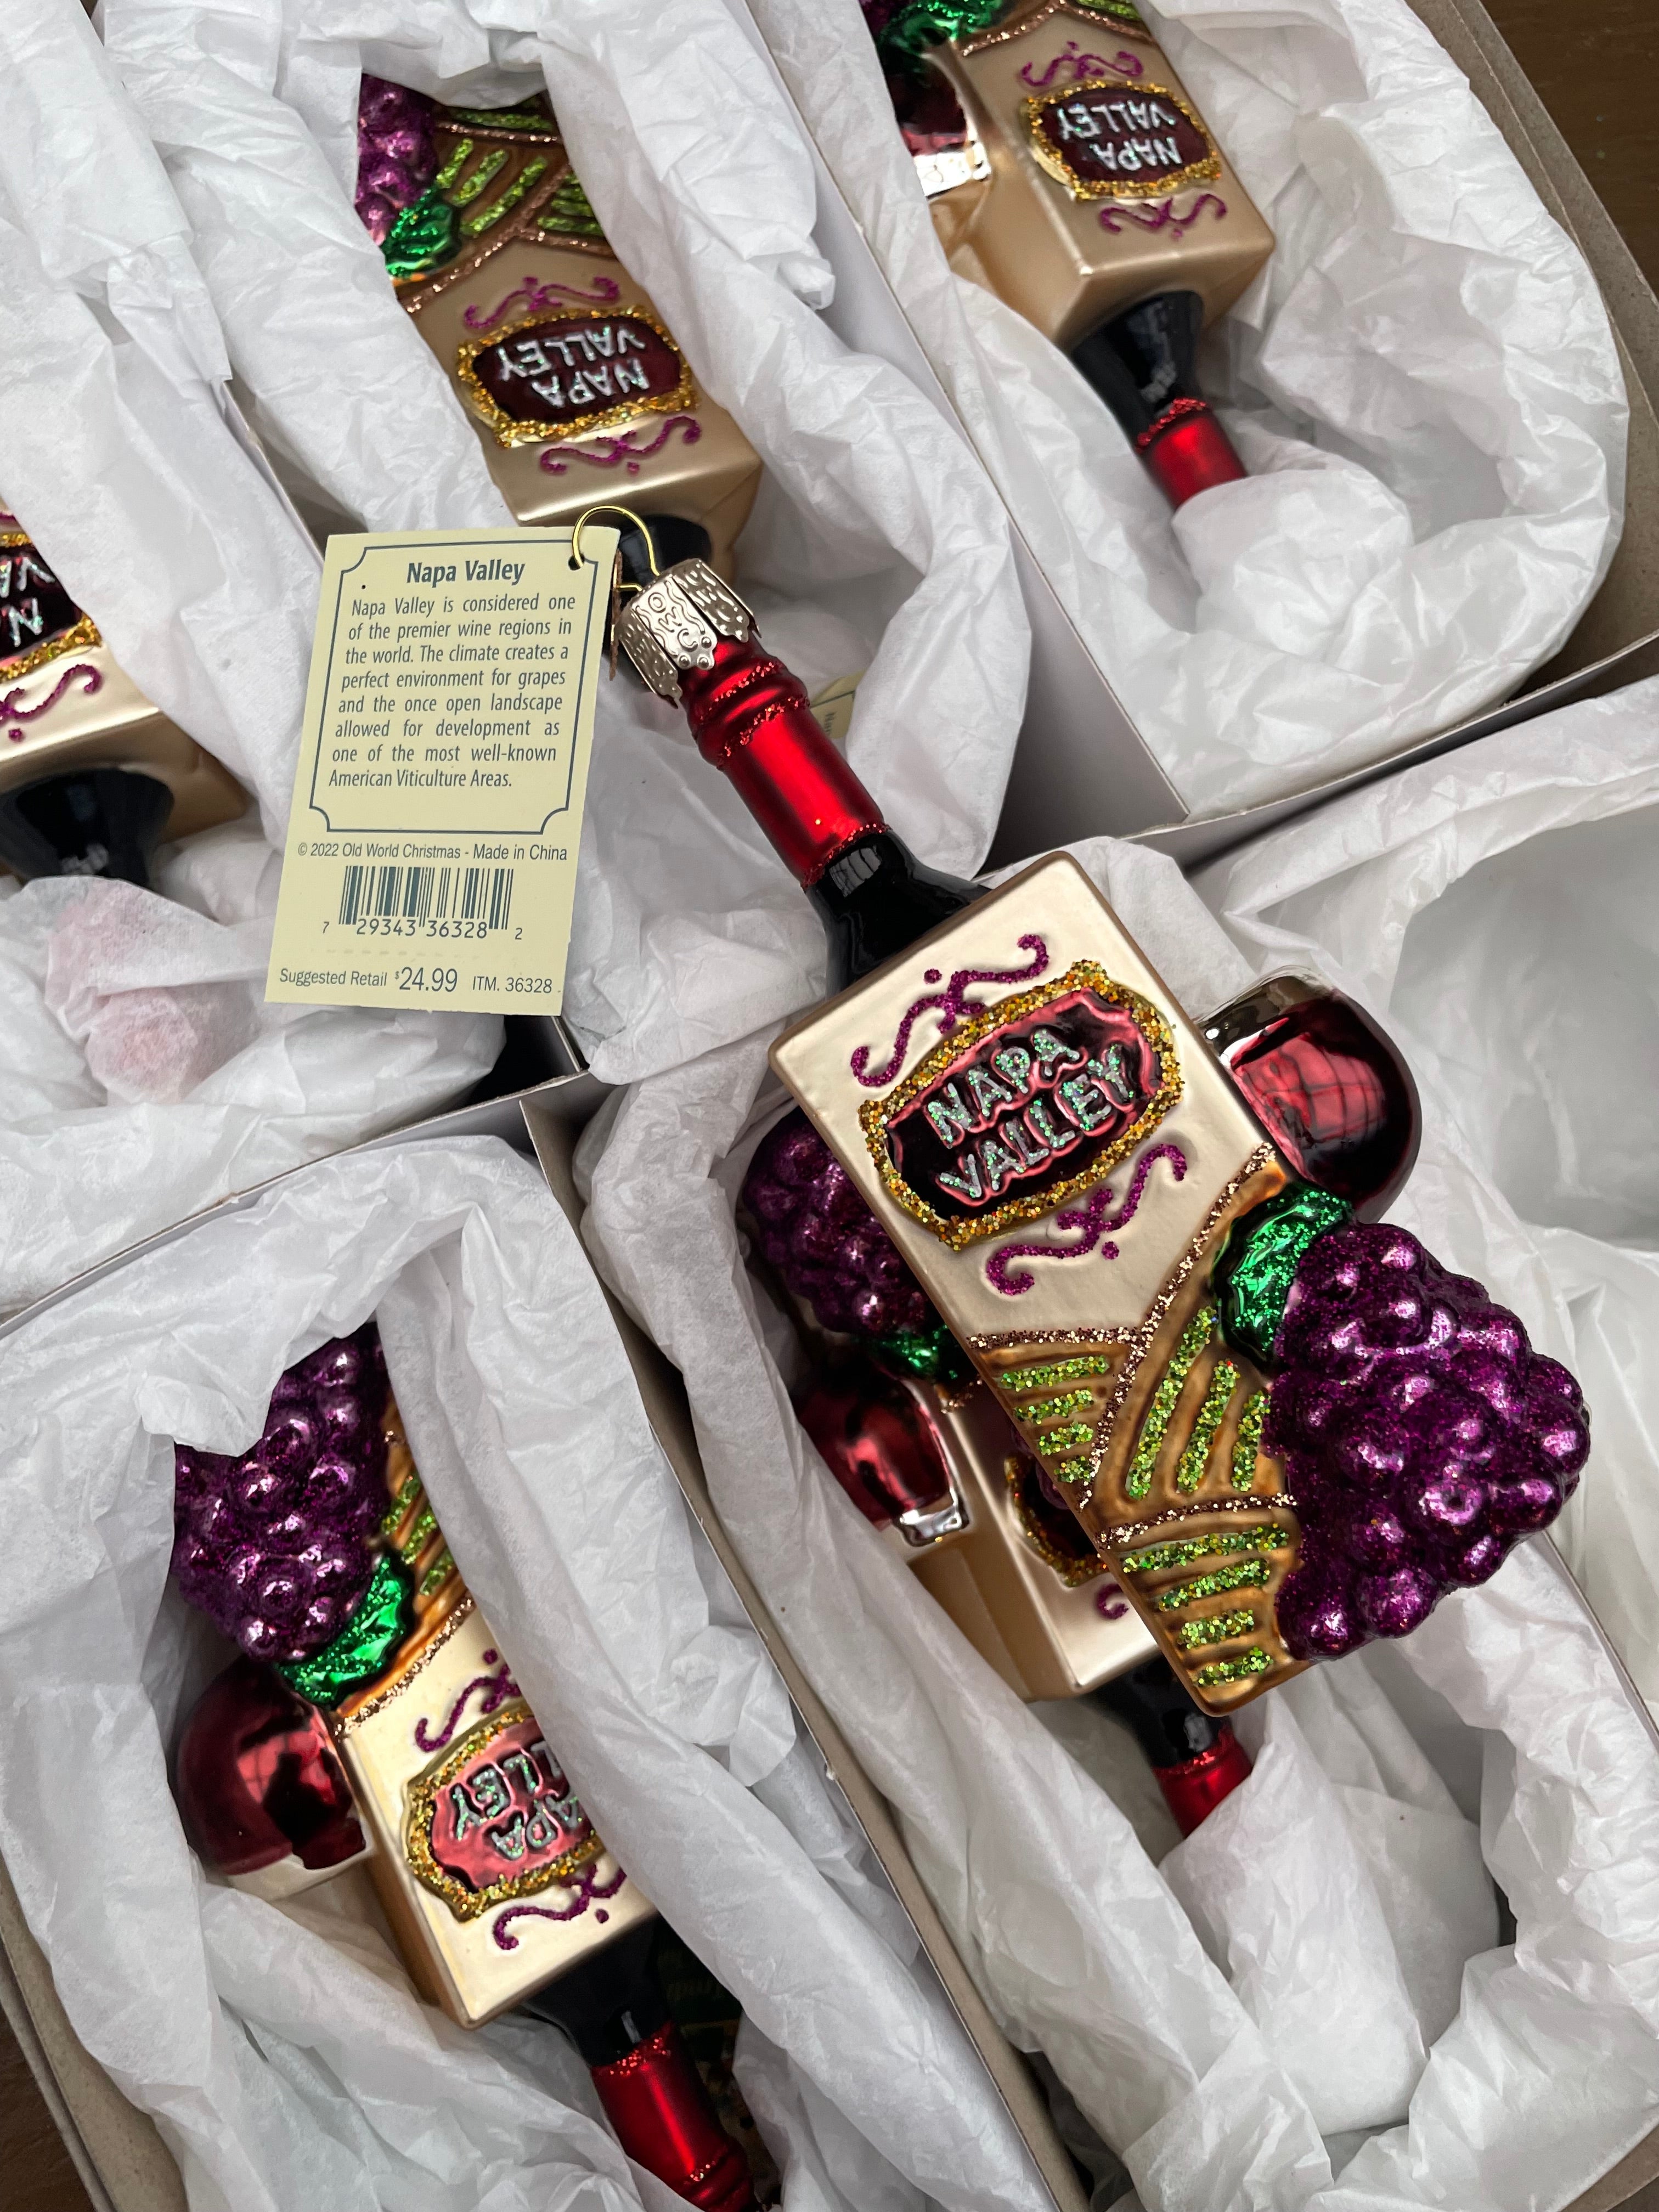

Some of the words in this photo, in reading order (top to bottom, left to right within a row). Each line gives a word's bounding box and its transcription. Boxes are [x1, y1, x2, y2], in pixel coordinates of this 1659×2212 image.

[1057, 100, 1177, 140] VALLEY
[1089, 136, 1183, 171] NAPA
[496, 325, 646, 382] VALLEY
[531, 358, 651, 408] NAPA
[406, 561, 457, 589] Napa
[465, 558, 526, 586] Valley
[351, 599, 386, 620] Napa
[394, 596, 435, 618] Valley
[443, 596, 454, 613] is
[462, 592, 540, 612] considered
[548, 596, 575, 611] one
[348, 622, 365, 641] of
[369, 622, 391, 640] the
[397, 620, 452, 644] premier
[458, 623, 492, 637] wine
[499, 618, 551, 641] regions
[558, 617, 572, 635] in
[345, 646, 368, 665] the
[373, 645, 414, 664] world.
[419, 644, 444, 663] The
[449, 643, 500, 662] climate
[505, 644, 555, 661] creates
[560, 646, 568, 659] a
[341, 669, 390, 693] perfect
[396, 670, 484, 688] environment
[491, 667, 512, 686] for
[517, 671, 566, 691] grapes
[338, 695, 365, 713] and
[373, 694, 396, 713] the
[404, 698, 437, 712] once
[446, 697, 481, 716] open
[490, 691, 563, 715] landscape
[335, 719, 391, 738] allowed
[403, 718, 424, 737] for
[436, 718, 532, 741] development
[544, 721, 560, 736] as
[332, 748, 358, 762] one
[367, 743, 384, 762] of
[392, 743, 415, 762] the
[424, 745, 461, 762] most
[471, 742, 556, 762] well-known
[328, 769, 392, 787] American
[397, 769, 467, 787] Viticulture
[469, 769, 512, 787] Areas.
[310, 842, 339, 857] 2022
[342, 842, 363, 857] Old
[366, 842, 399, 858] World
[403, 843, 461, 859] Christmas
[473, 843, 509, 860] Made
[513, 843, 524, 860] in
[529, 844, 567, 861] China
[356, 917, 416, 936] 29343
[425, 919, 488, 939] 36328
[279, 968, 347, 987] Suggested
[350, 970, 388, 987] Retail
[394, 966, 458, 993] $24.99
[472, 975, 500, 992] ITM.
[505, 977, 552, 994] 36328
[926, 1028, 1080, 1148] NAPA
[938, 1043, 1135, 1198] VALLEY
[452, 1740, 561, 1841] LLEY
[491, 1790, 579, 1860] APA
